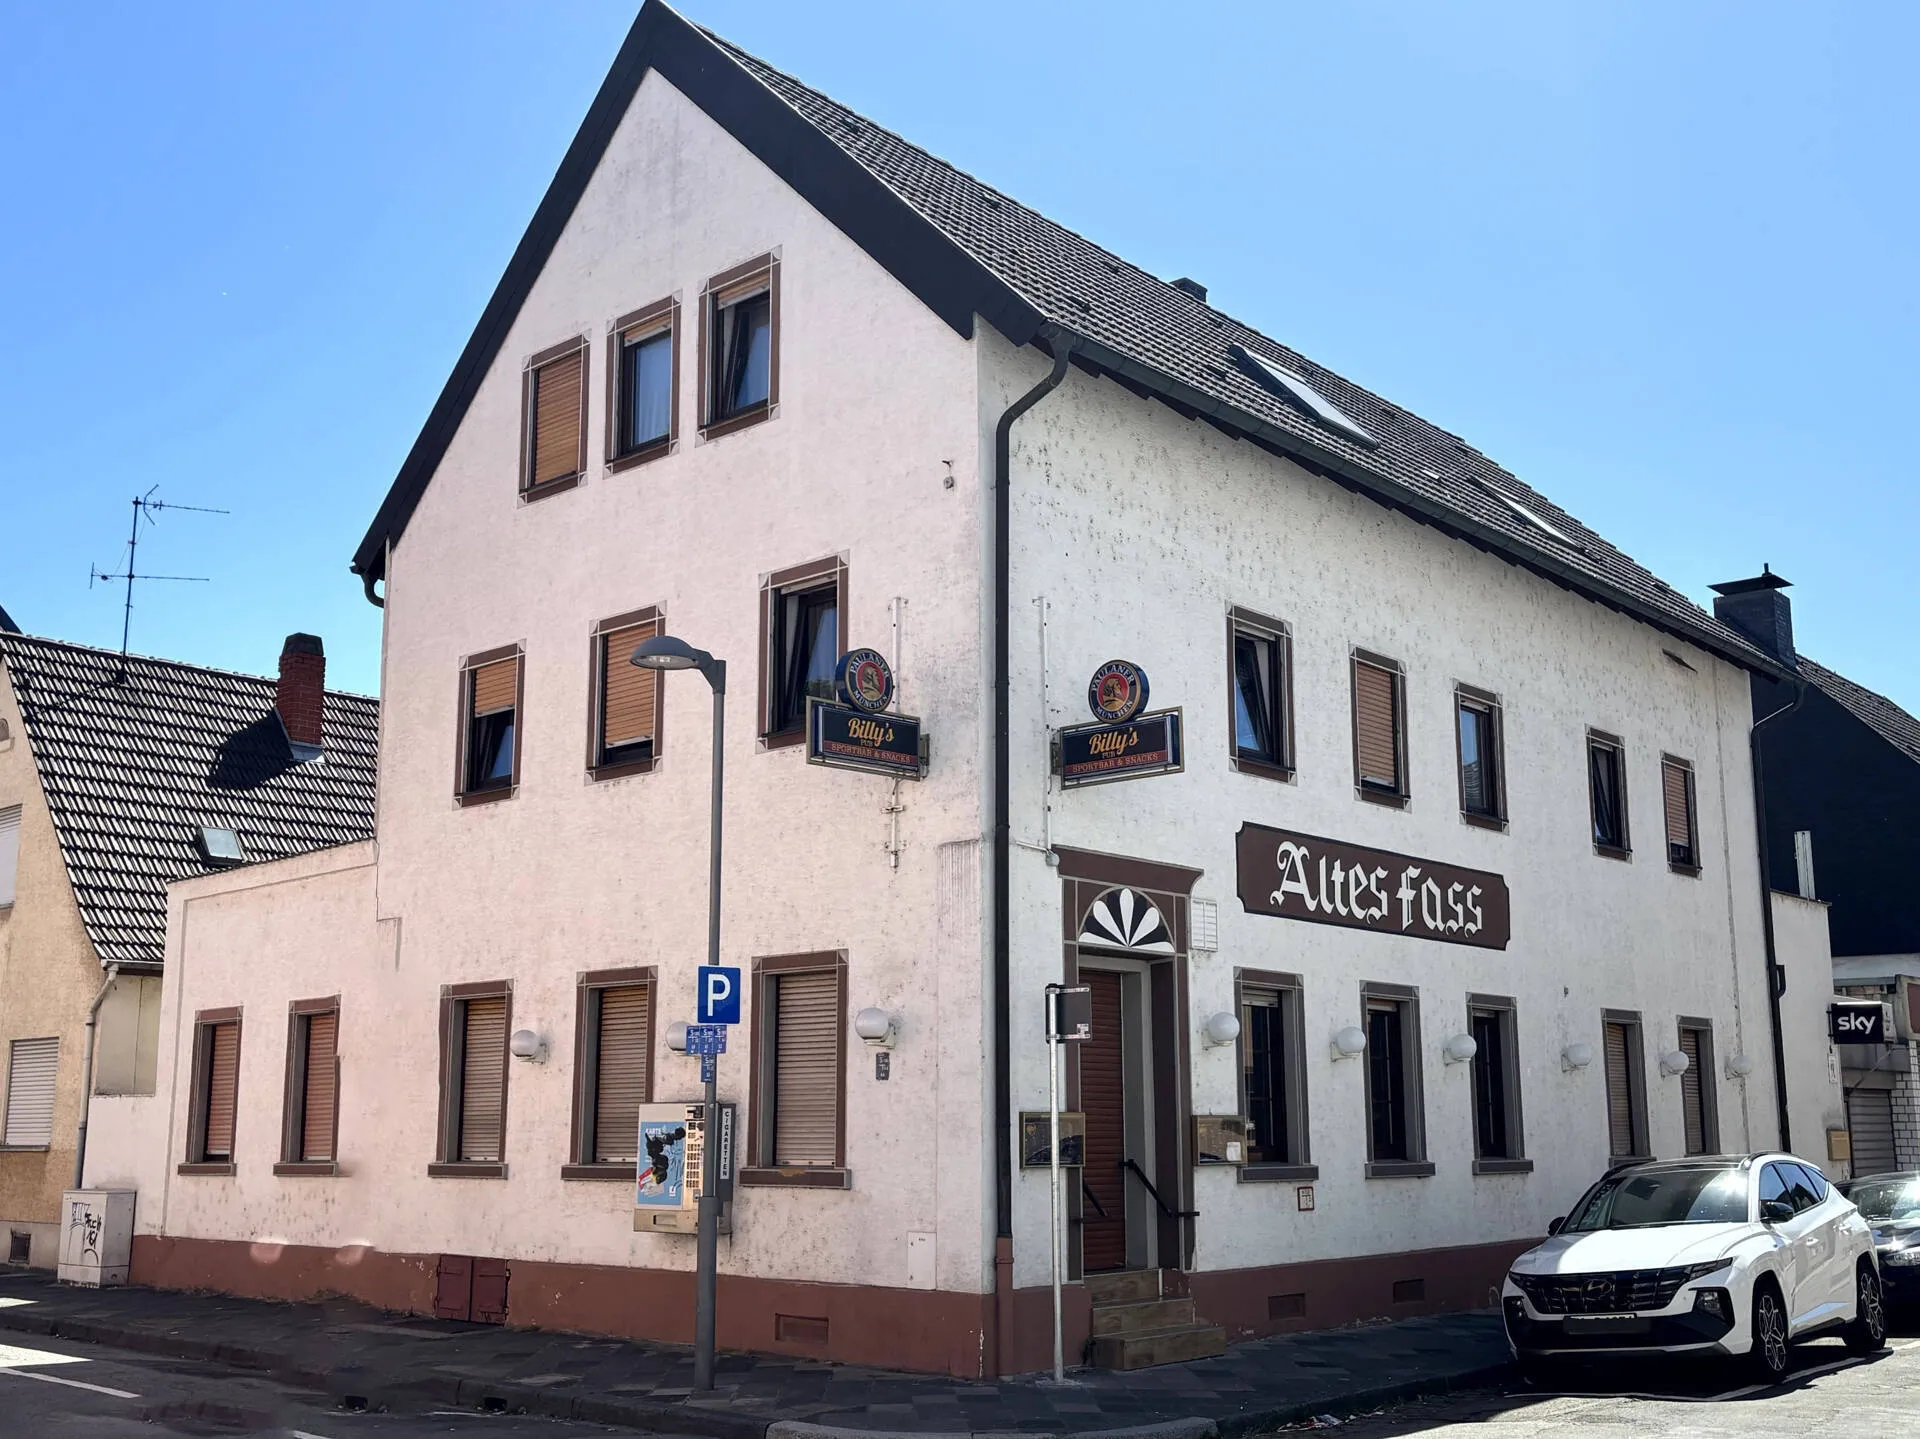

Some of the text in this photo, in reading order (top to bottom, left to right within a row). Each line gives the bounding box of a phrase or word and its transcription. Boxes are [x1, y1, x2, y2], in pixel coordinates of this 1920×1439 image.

[849, 652, 891, 679] PAULANER
[1091, 664, 1136, 692] PAULANER
[848, 717, 895, 747] Billy's
[860, 739, 873, 747] PUB
[1088, 727, 1140, 757] Billy's
[831, 743, 872, 758] SPORTBAR
[881, 751, 911, 764] SNACKS
[1072, 759, 1115, 773] SPORTBAR
[1125, 752, 1159, 765] SNACKS
[1101, 752, 1116, 760] PUB
[1269, 840, 1390, 925] Altes
[707, 973, 731, 1017] P
[1837, 1011, 1876, 1035] sky
[722, 1111, 731, 1177] CIGARETTEN
